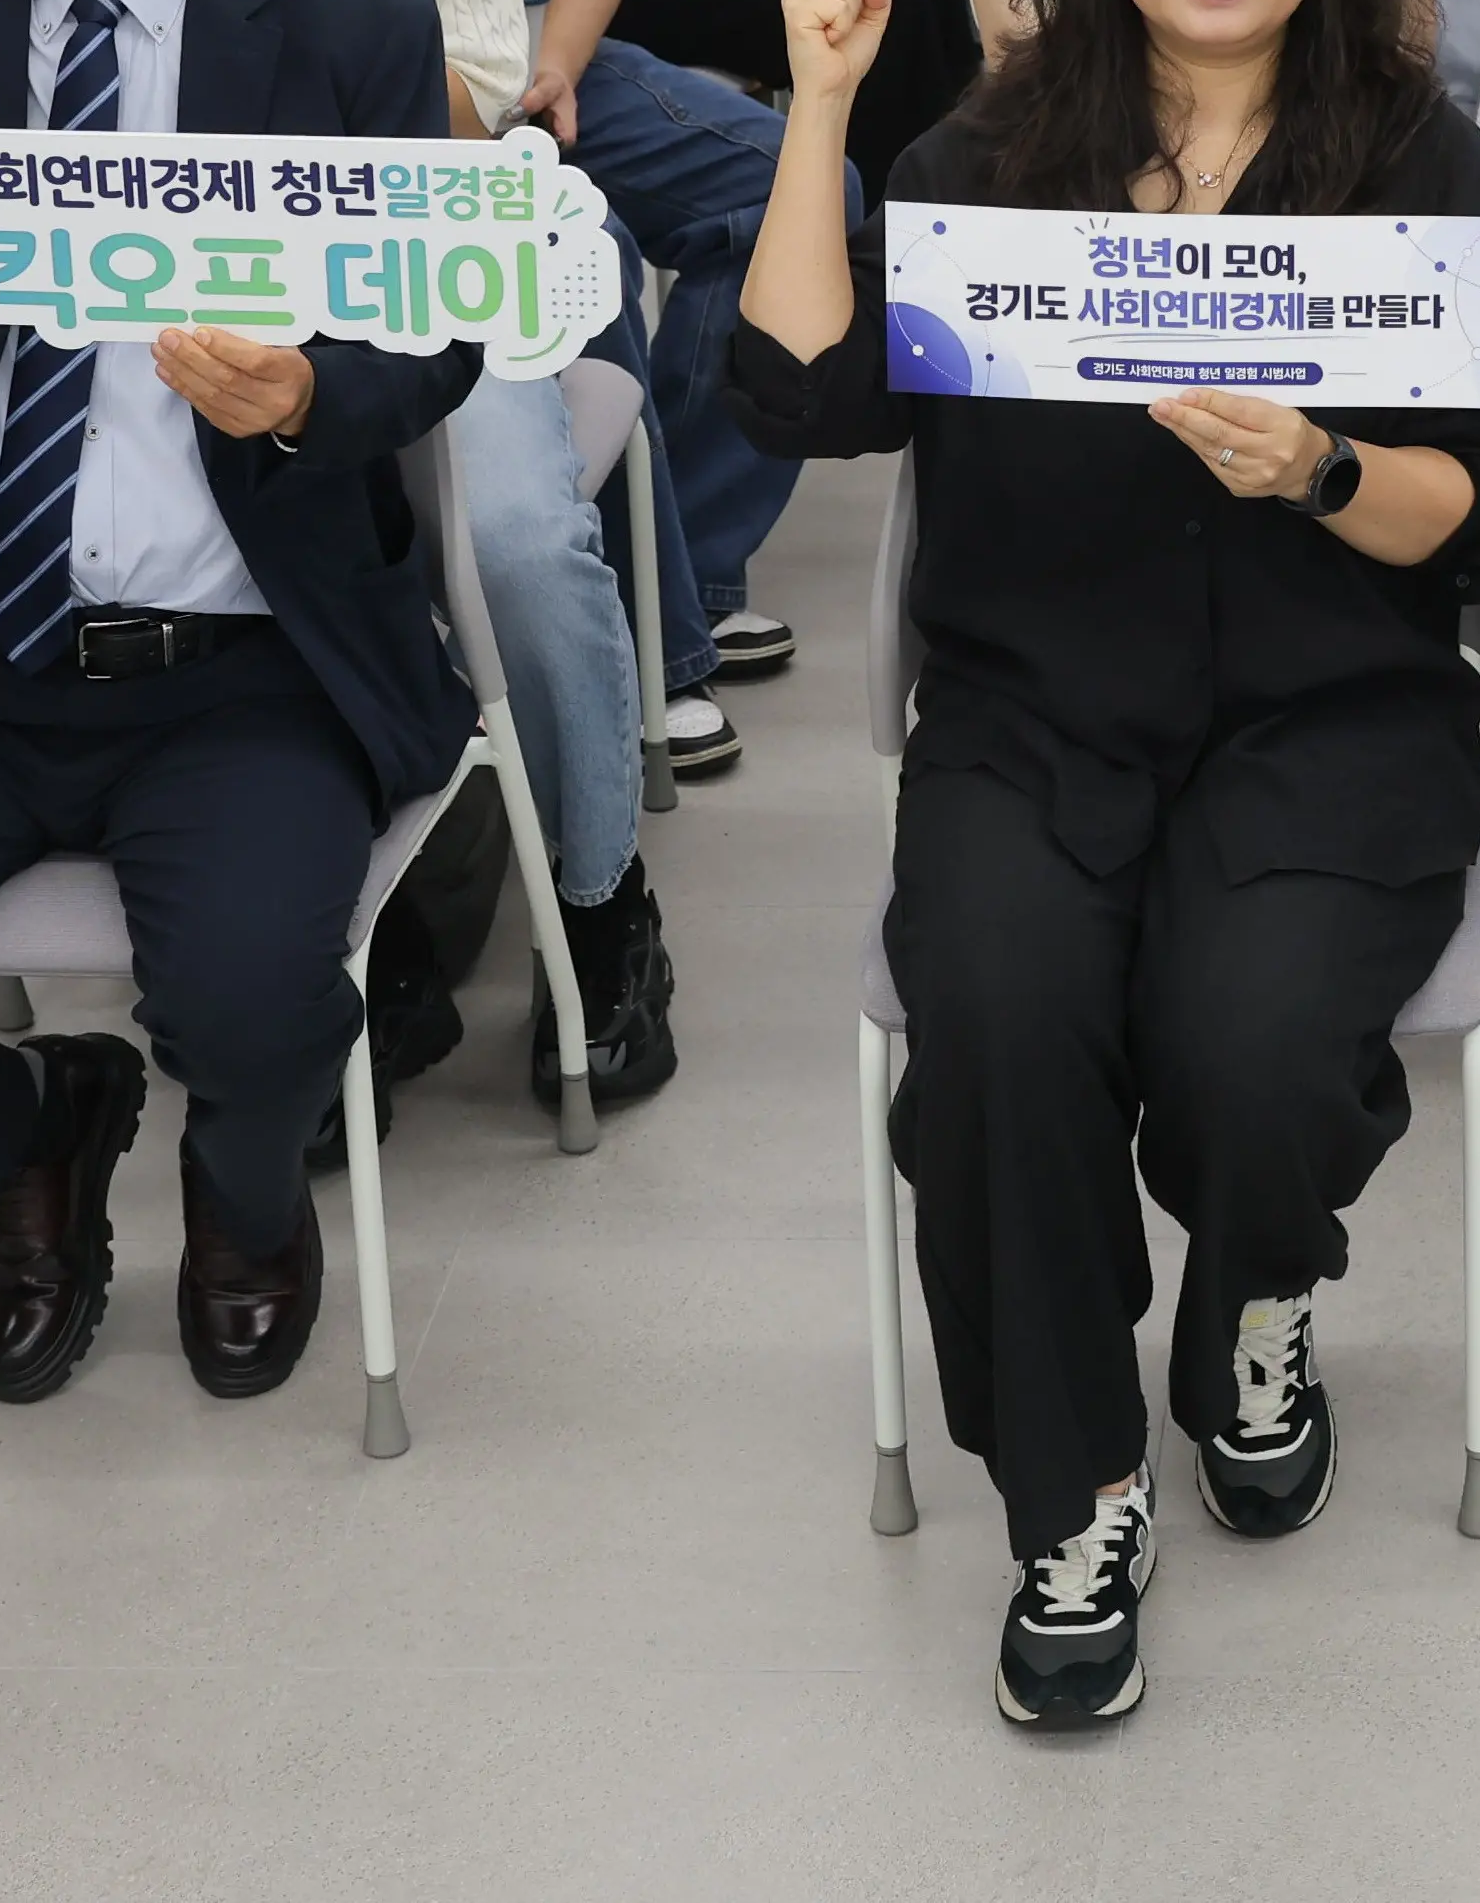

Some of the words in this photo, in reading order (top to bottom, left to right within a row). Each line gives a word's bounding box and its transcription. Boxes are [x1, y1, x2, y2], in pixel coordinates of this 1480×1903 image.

[271, 150, 534, 222] 청년일경험
[1088, 236, 1210, 279] 청년이
[1223, 244, 1307, 285] 모여,
[966, 283, 1069, 320] 경기도
[1077, 288, 1335, 330] 사회연대경제를
[1343, 294, 1445, 328] 만들다
[1093, 362, 1126, 376] 경기도
[1129, 363, 1195, 379] 사회연대경제
[1198, 365, 1221, 379] 청년
[1224, 367, 1258, 381] 일경험
[1261, 367, 1307, 381] 시범사업
